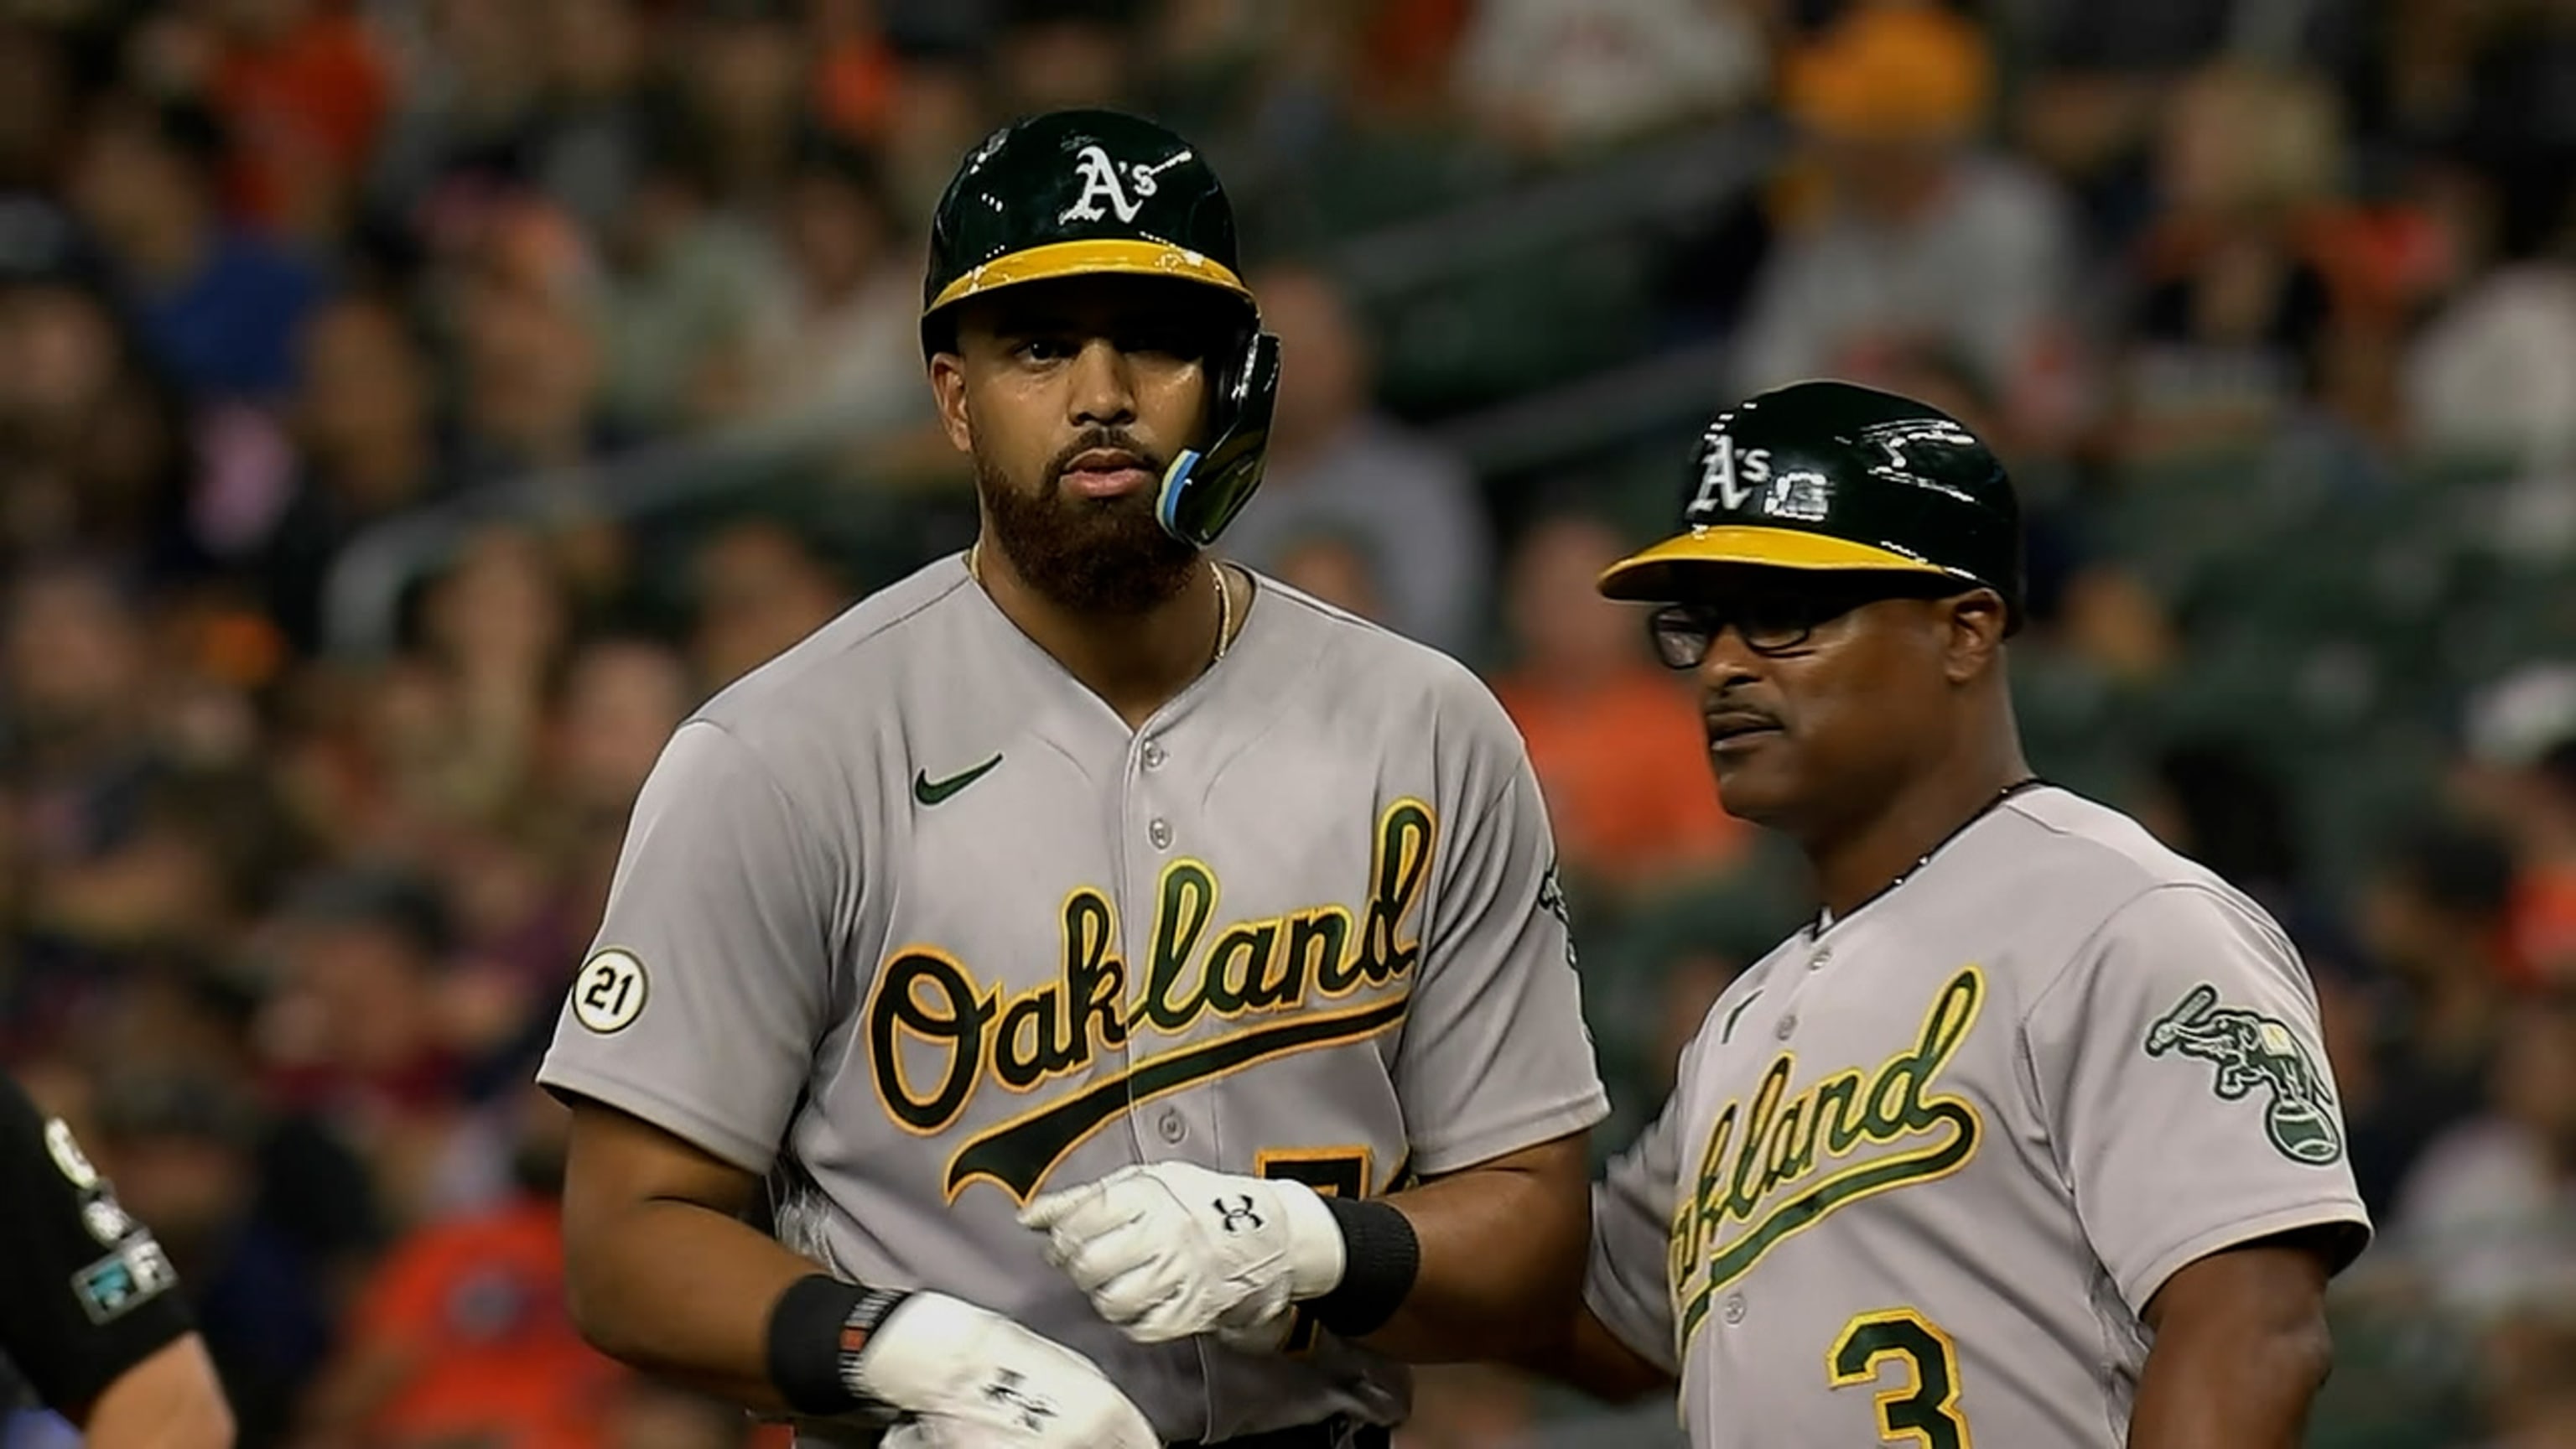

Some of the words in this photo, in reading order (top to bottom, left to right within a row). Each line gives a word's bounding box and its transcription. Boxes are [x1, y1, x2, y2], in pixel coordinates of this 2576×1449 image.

[1058, 146, 1158, 226] A's
[1685, 434, 1772, 521] A's
[584, 965, 634, 1015] 21
[867, 797, 1436, 1136] Oakland
[1668, 963, 1985, 1293] akland
[1824, 1306, 1973, 1449] 3
